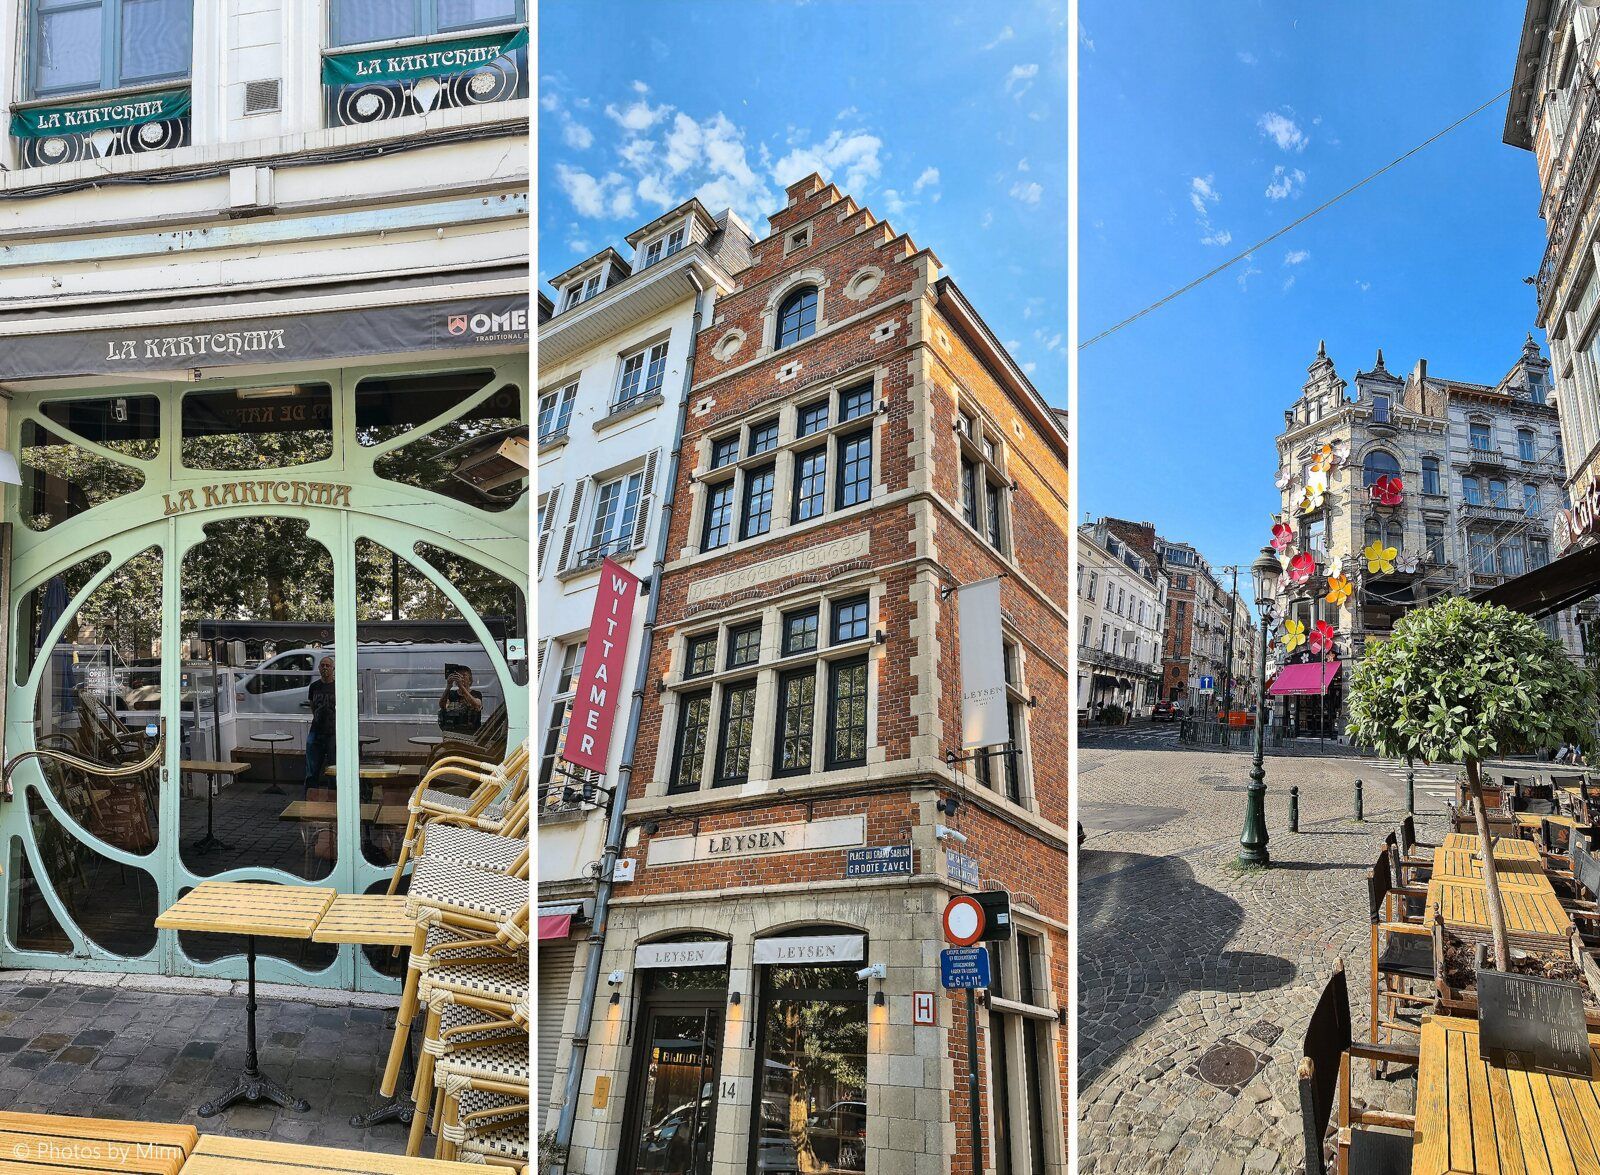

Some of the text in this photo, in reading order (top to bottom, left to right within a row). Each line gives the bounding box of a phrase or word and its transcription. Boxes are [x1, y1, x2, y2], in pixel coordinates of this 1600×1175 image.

[356, 58, 382, 76] LA
[37, 113, 61, 129] LA
[470, 308, 529, 333] OME
[476, 334, 521, 342] TRADITIONAL
[105, 340, 137, 360] LA
[162, 488, 197, 516] LA
[580, 574, 628, 756] WITTAMER
[963, 685, 1003, 700] LEYSEN
[708, 830, 786, 853] LEYSEN
[850, 847, 910, 861] PLACE DU GRAND SABLON
[848, 861, 911, 874] GROOTE ZAVEL
[655, 949, 705, 963] LEYSEN
[777, 944, 837, 959] LEYSEN
[955, 976, 961, 986] 6
[972, 976, 978, 986] 11
[918, 997, 930, 1018] H
[721, 1081, 736, 1099] 14
